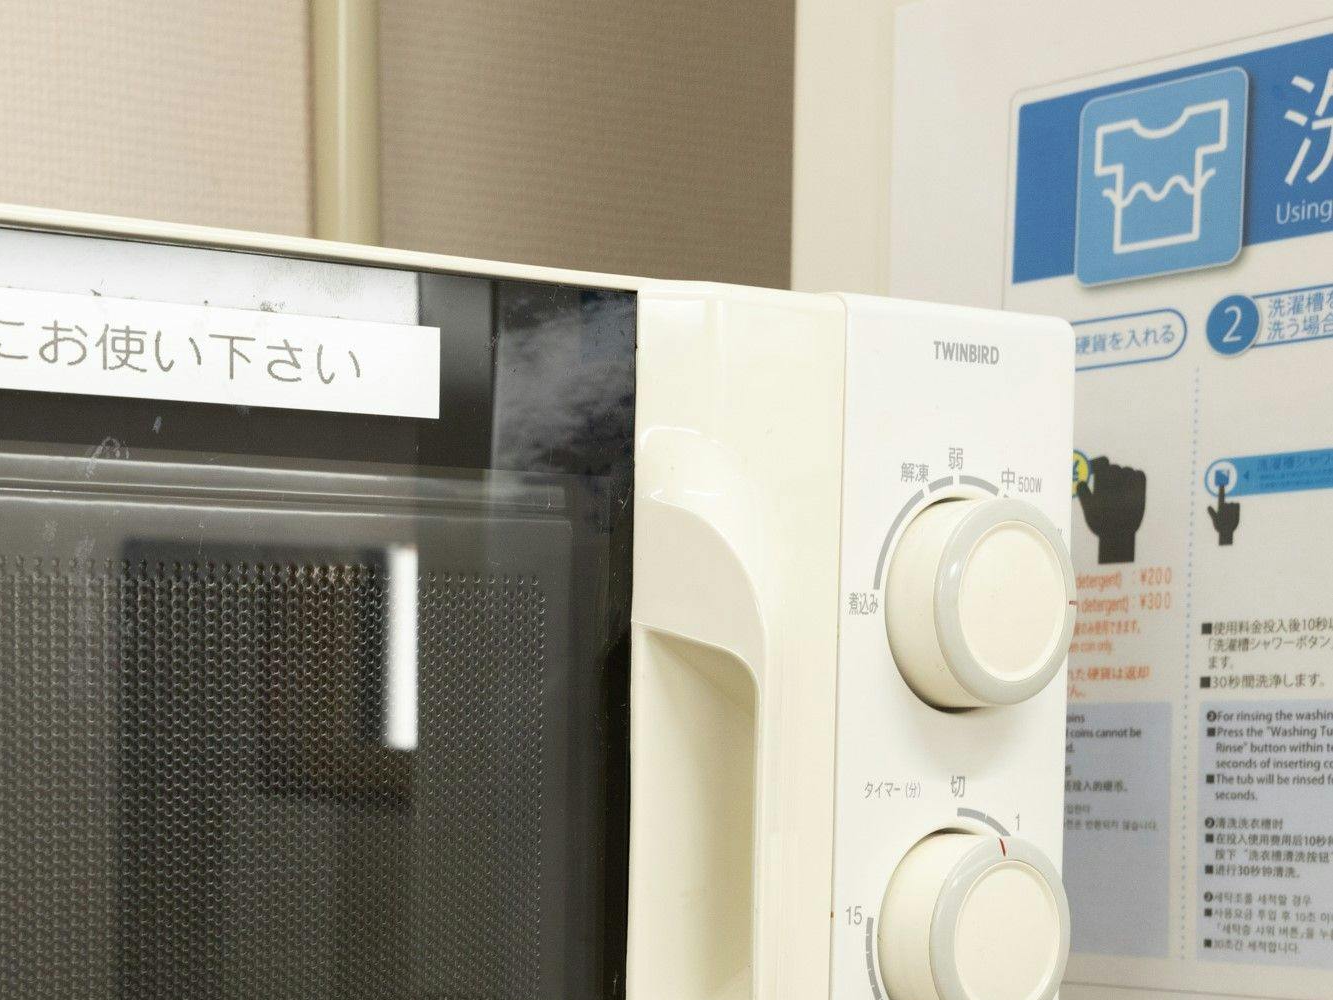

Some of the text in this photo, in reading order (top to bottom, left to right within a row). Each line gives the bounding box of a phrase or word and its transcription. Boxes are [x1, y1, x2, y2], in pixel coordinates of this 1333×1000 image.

[1276, 200, 1333, 225] Using
[1222, 305, 1243, 343] 2
[933, 340, 1000, 365] TWINBIRD
[948, 447, 963, 470] 弱
[900, 461, 930, 483] 解凍
[1001, 467, 1042, 493] 中 500W
[849, 591, 878, 615] 煮込み
[1237, 710, 1272, 724] rinsing
[1275, 709, 1293, 721] the
[1217, 728, 1243, 738] Press
[1247, 727, 1263, 738] the
[1251, 741, 1286, 753] button
[1289, 742, 1323, 753] within
[1216, 759, 1257, 769] seconds
[1260, 758, 1271, 769] of
[1273, 759, 1321, 771] inserting
[951, 775, 966, 798] 切
[1217, 774, 1234, 785] The
[1237, 774, 1254, 785] tub
[1257, 774, 1274, 785] will
[1277, 774, 1290, 785] be
[1293, 774, 1325, 785] rinsed
[1015, 813, 1021, 831] 1
[846, 906, 863, 925] 15
